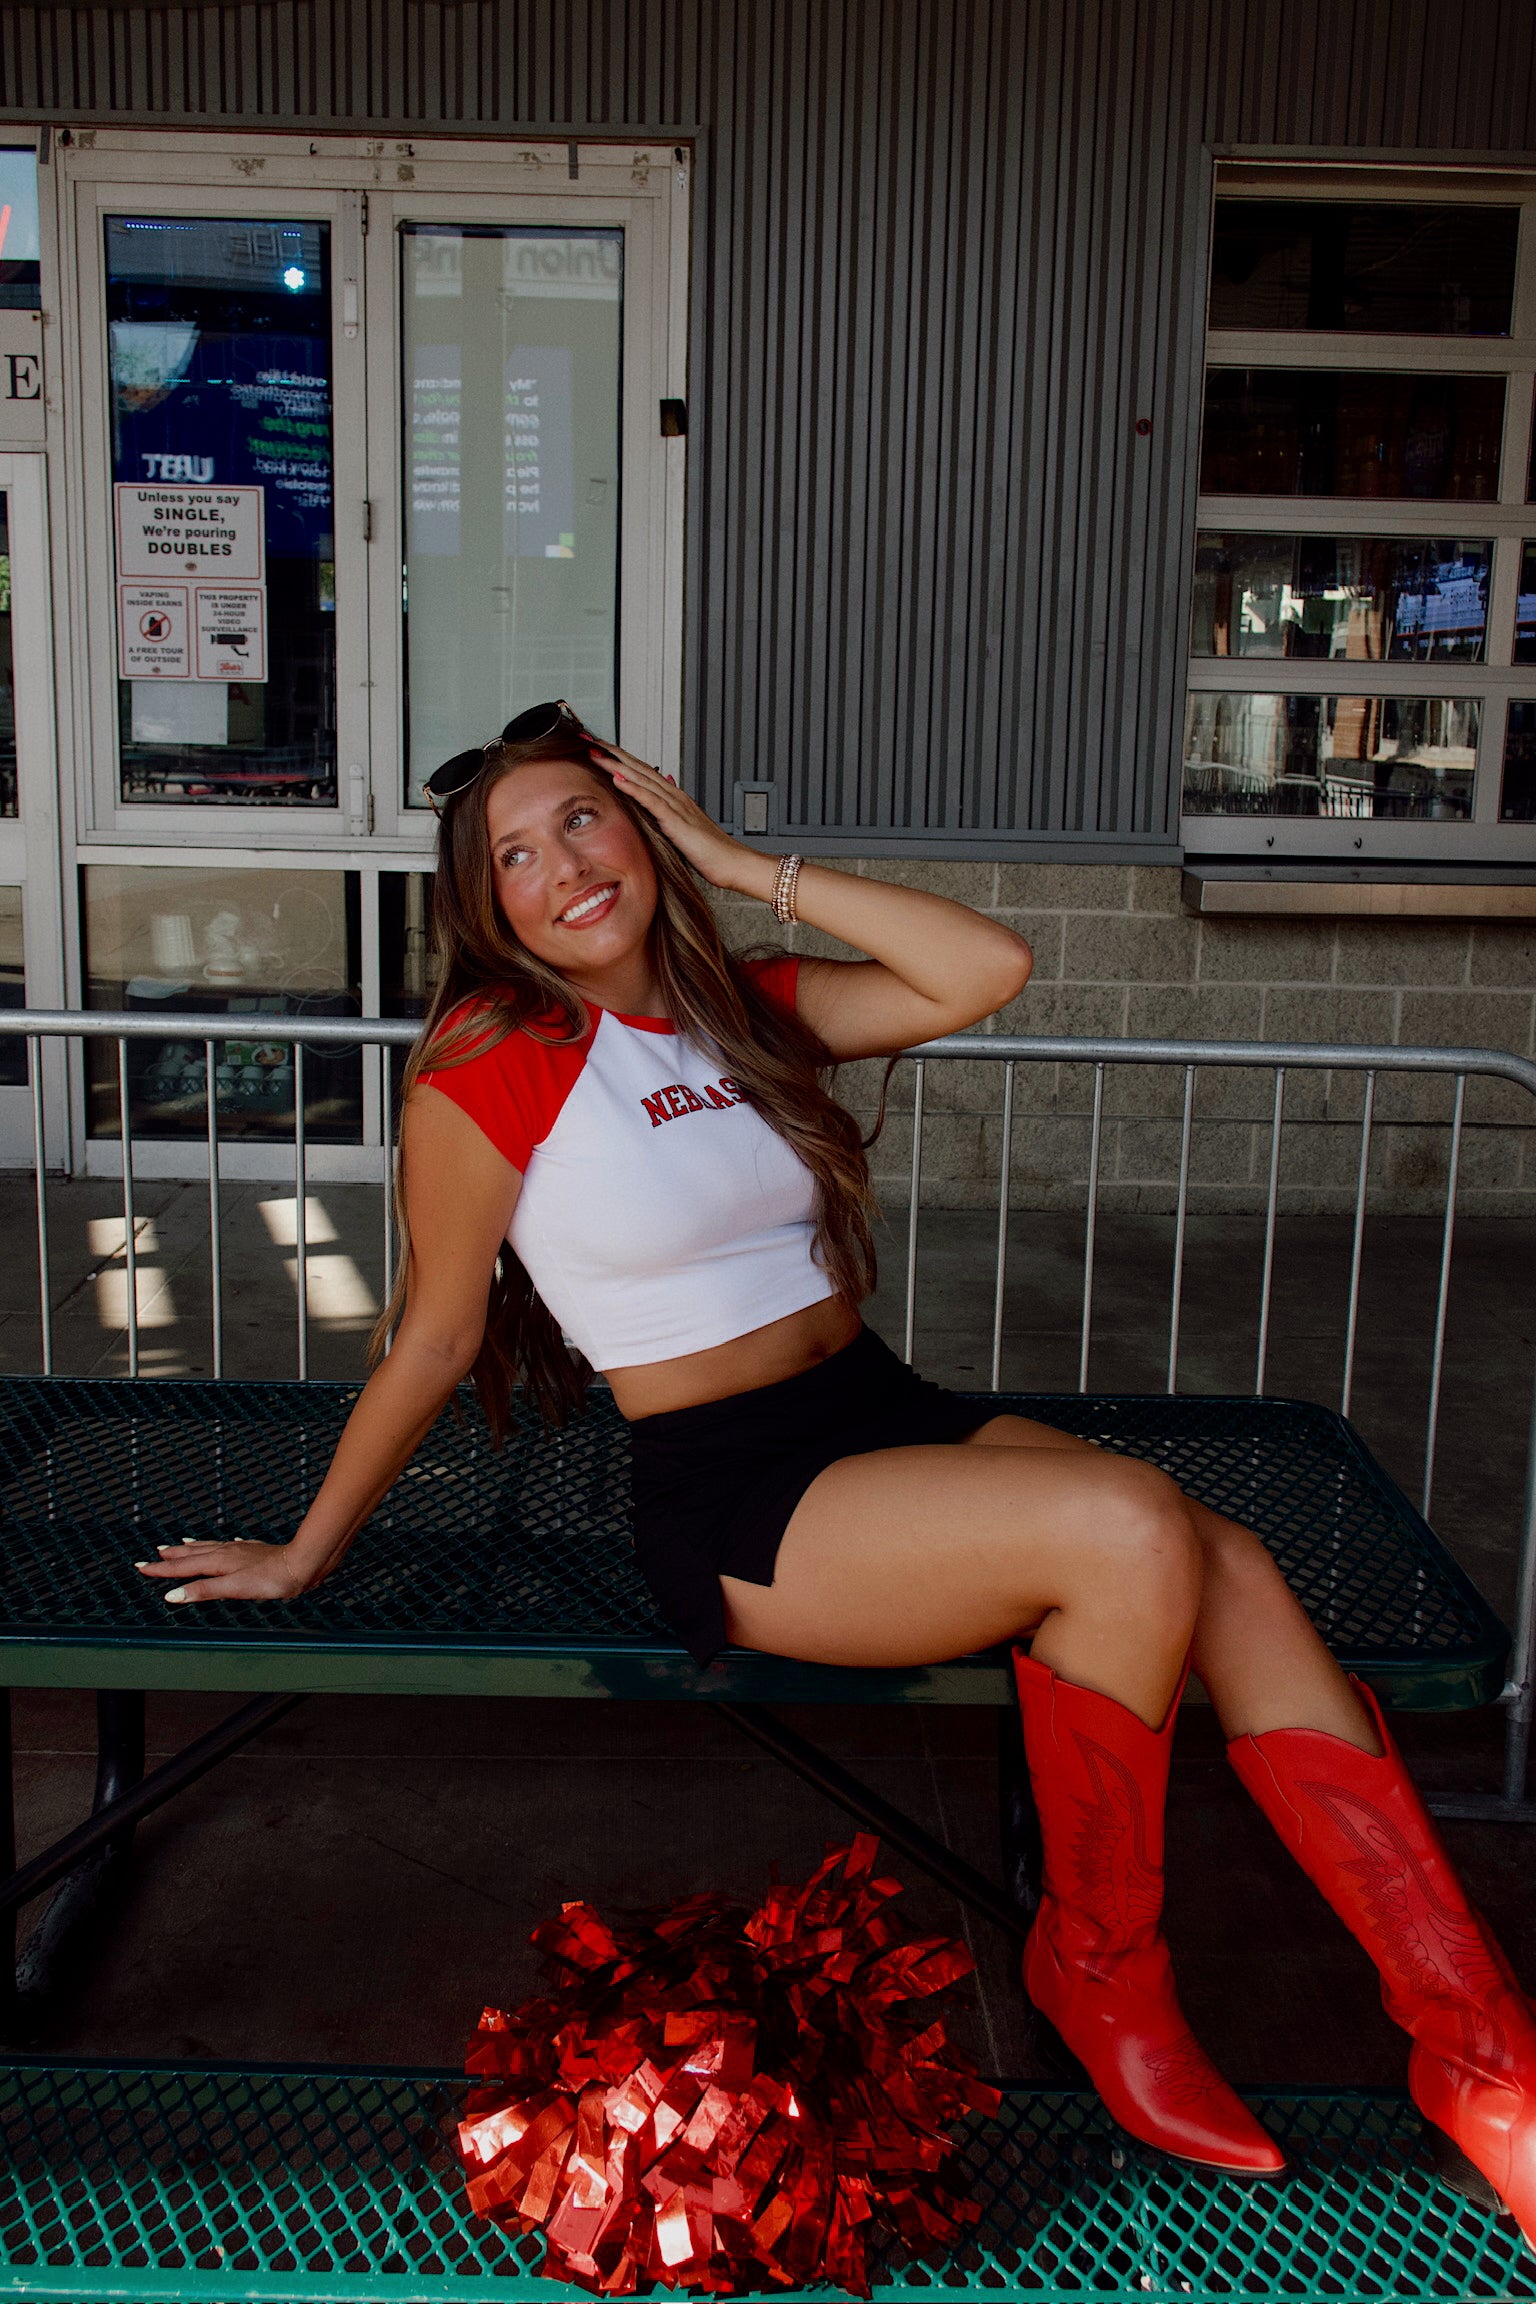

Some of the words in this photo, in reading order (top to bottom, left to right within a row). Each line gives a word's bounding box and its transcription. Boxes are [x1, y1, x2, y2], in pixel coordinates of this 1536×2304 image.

[138, 491, 184, 503] Unless
[188, 494, 212, 506] you
[217, 495, 240, 506] say
[154, 508, 225, 524] SINGLE,
[142, 525, 181, 537] We're
[185, 527, 236, 541] pouring
[148, 542, 232, 556] DOUBLES
[127, 599, 153, 607] INSIDE
[144, 656, 182, 664] OUTSIDE
[640, 1077, 748, 1128] NEBAS
